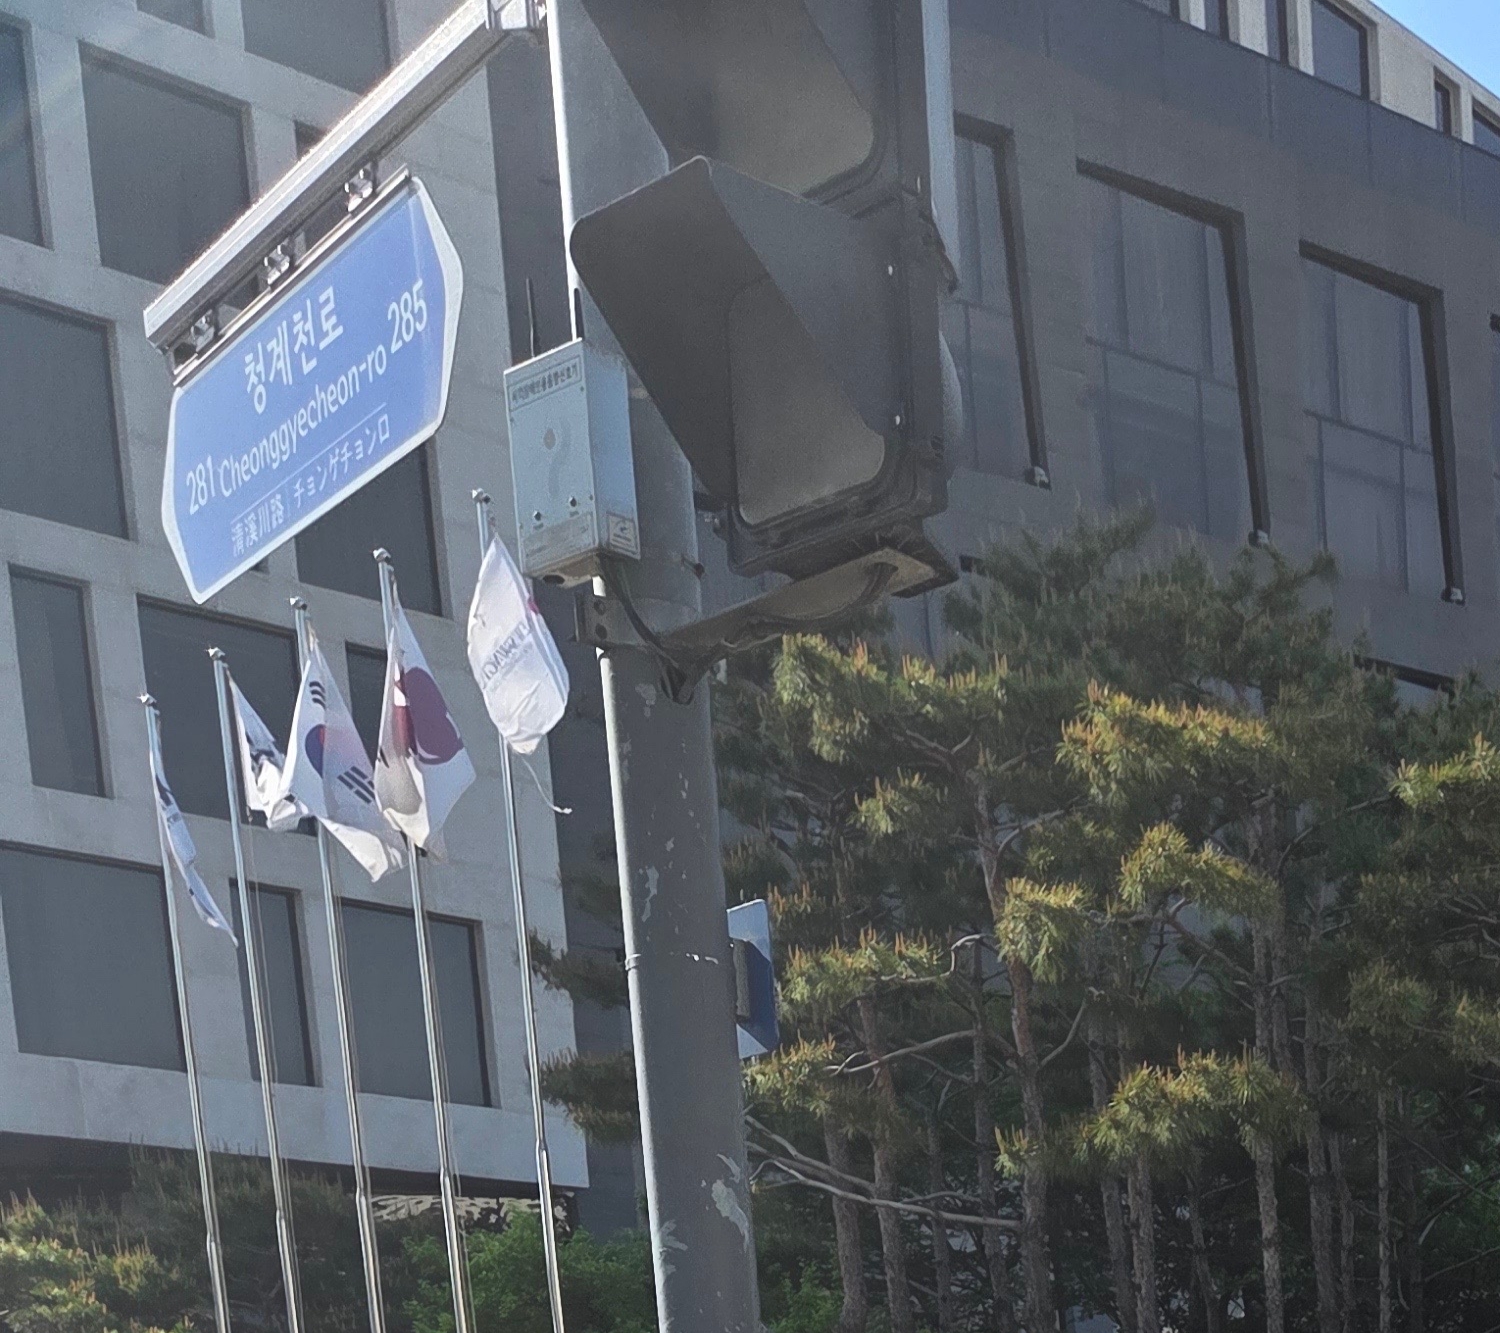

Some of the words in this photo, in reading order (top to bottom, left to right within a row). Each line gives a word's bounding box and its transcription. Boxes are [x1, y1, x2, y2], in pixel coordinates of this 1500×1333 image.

[186, 455, 216, 516] 281
[218, 345, 387, 499] Cheonggyecheon-ro
[386, 279, 428, 354] 285
[244, 286, 344, 415] 청계천로
